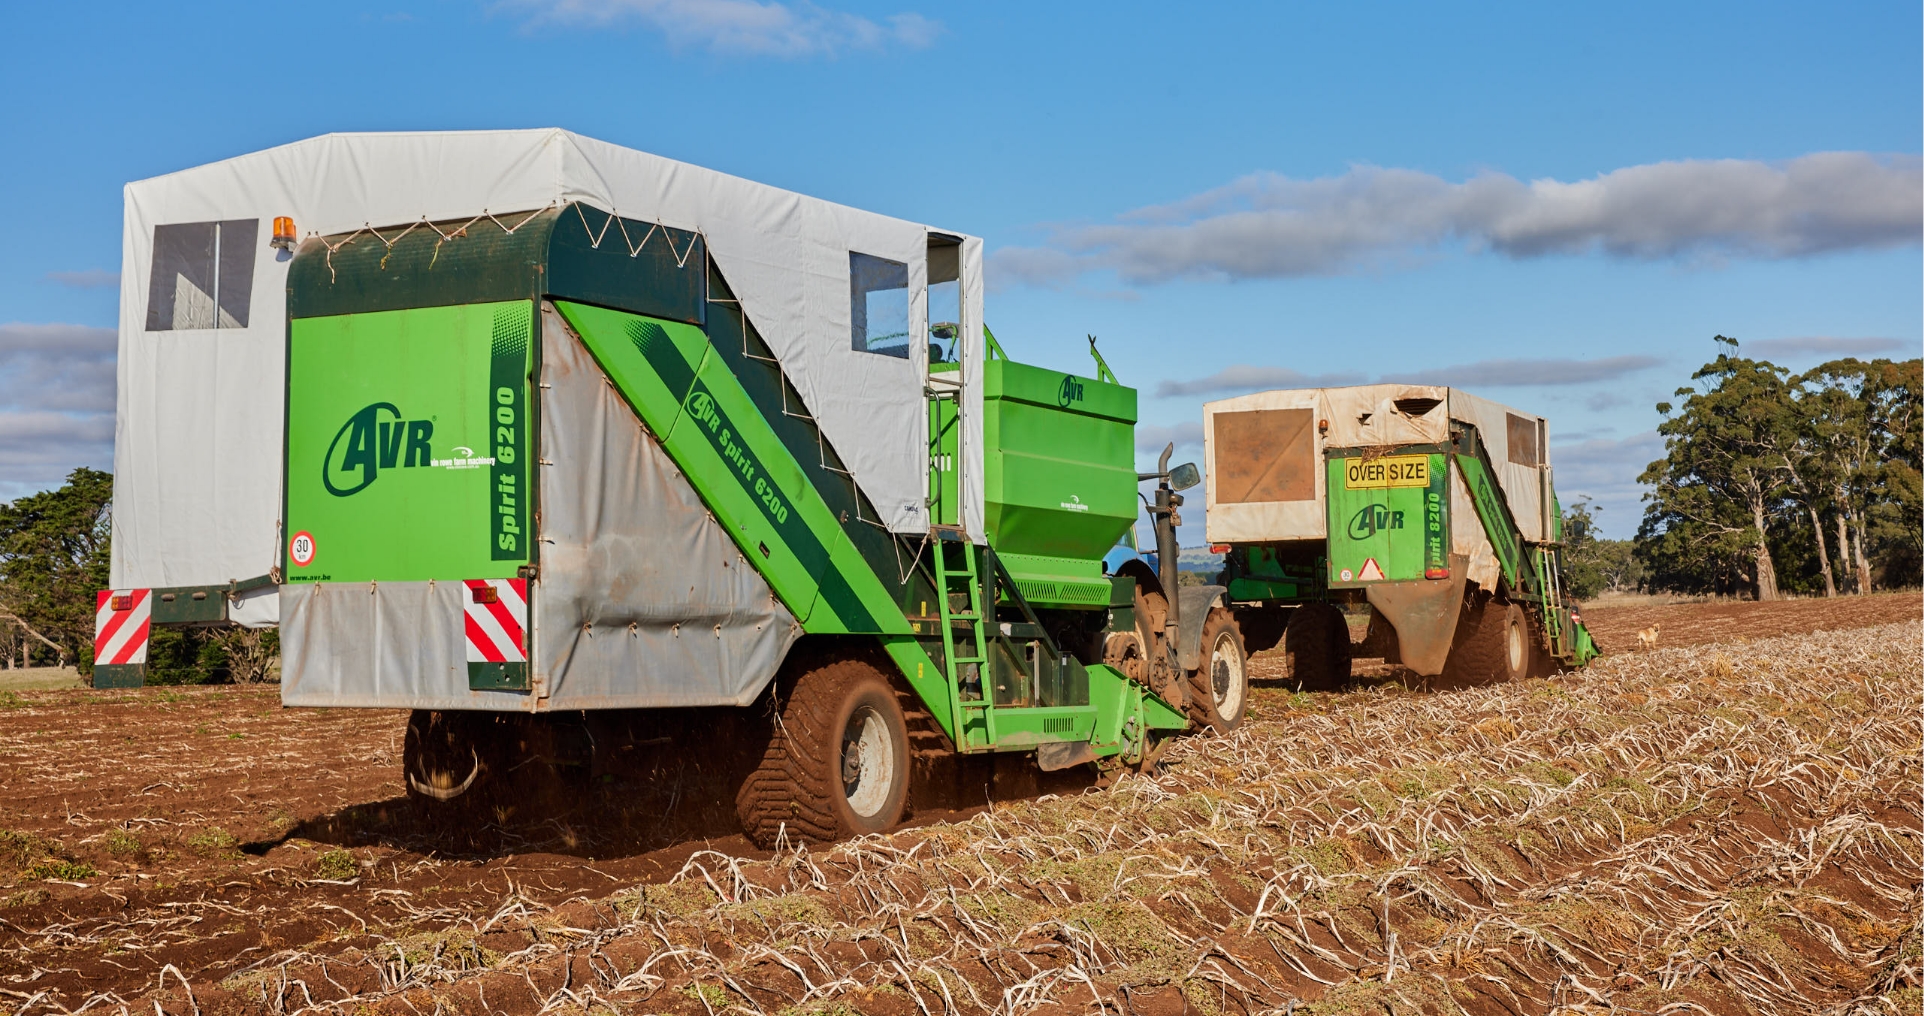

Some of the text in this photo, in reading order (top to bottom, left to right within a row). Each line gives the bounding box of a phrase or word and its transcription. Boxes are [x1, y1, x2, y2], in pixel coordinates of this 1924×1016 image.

[1058, 374, 1083, 408] AVR
[323, 402, 434, 497] AVR
[467, 456, 496, 467] machinery
[687, 391, 788, 524] AVR Spirit 6200
[496, 386, 520, 552] Spirit 6200
[1349, 463, 1425, 482] OVER SIZE
[1348, 504, 1404, 541] AVR
[1428, 492, 1444, 570] pirit 8200
[296, 539, 309, 553] 30
